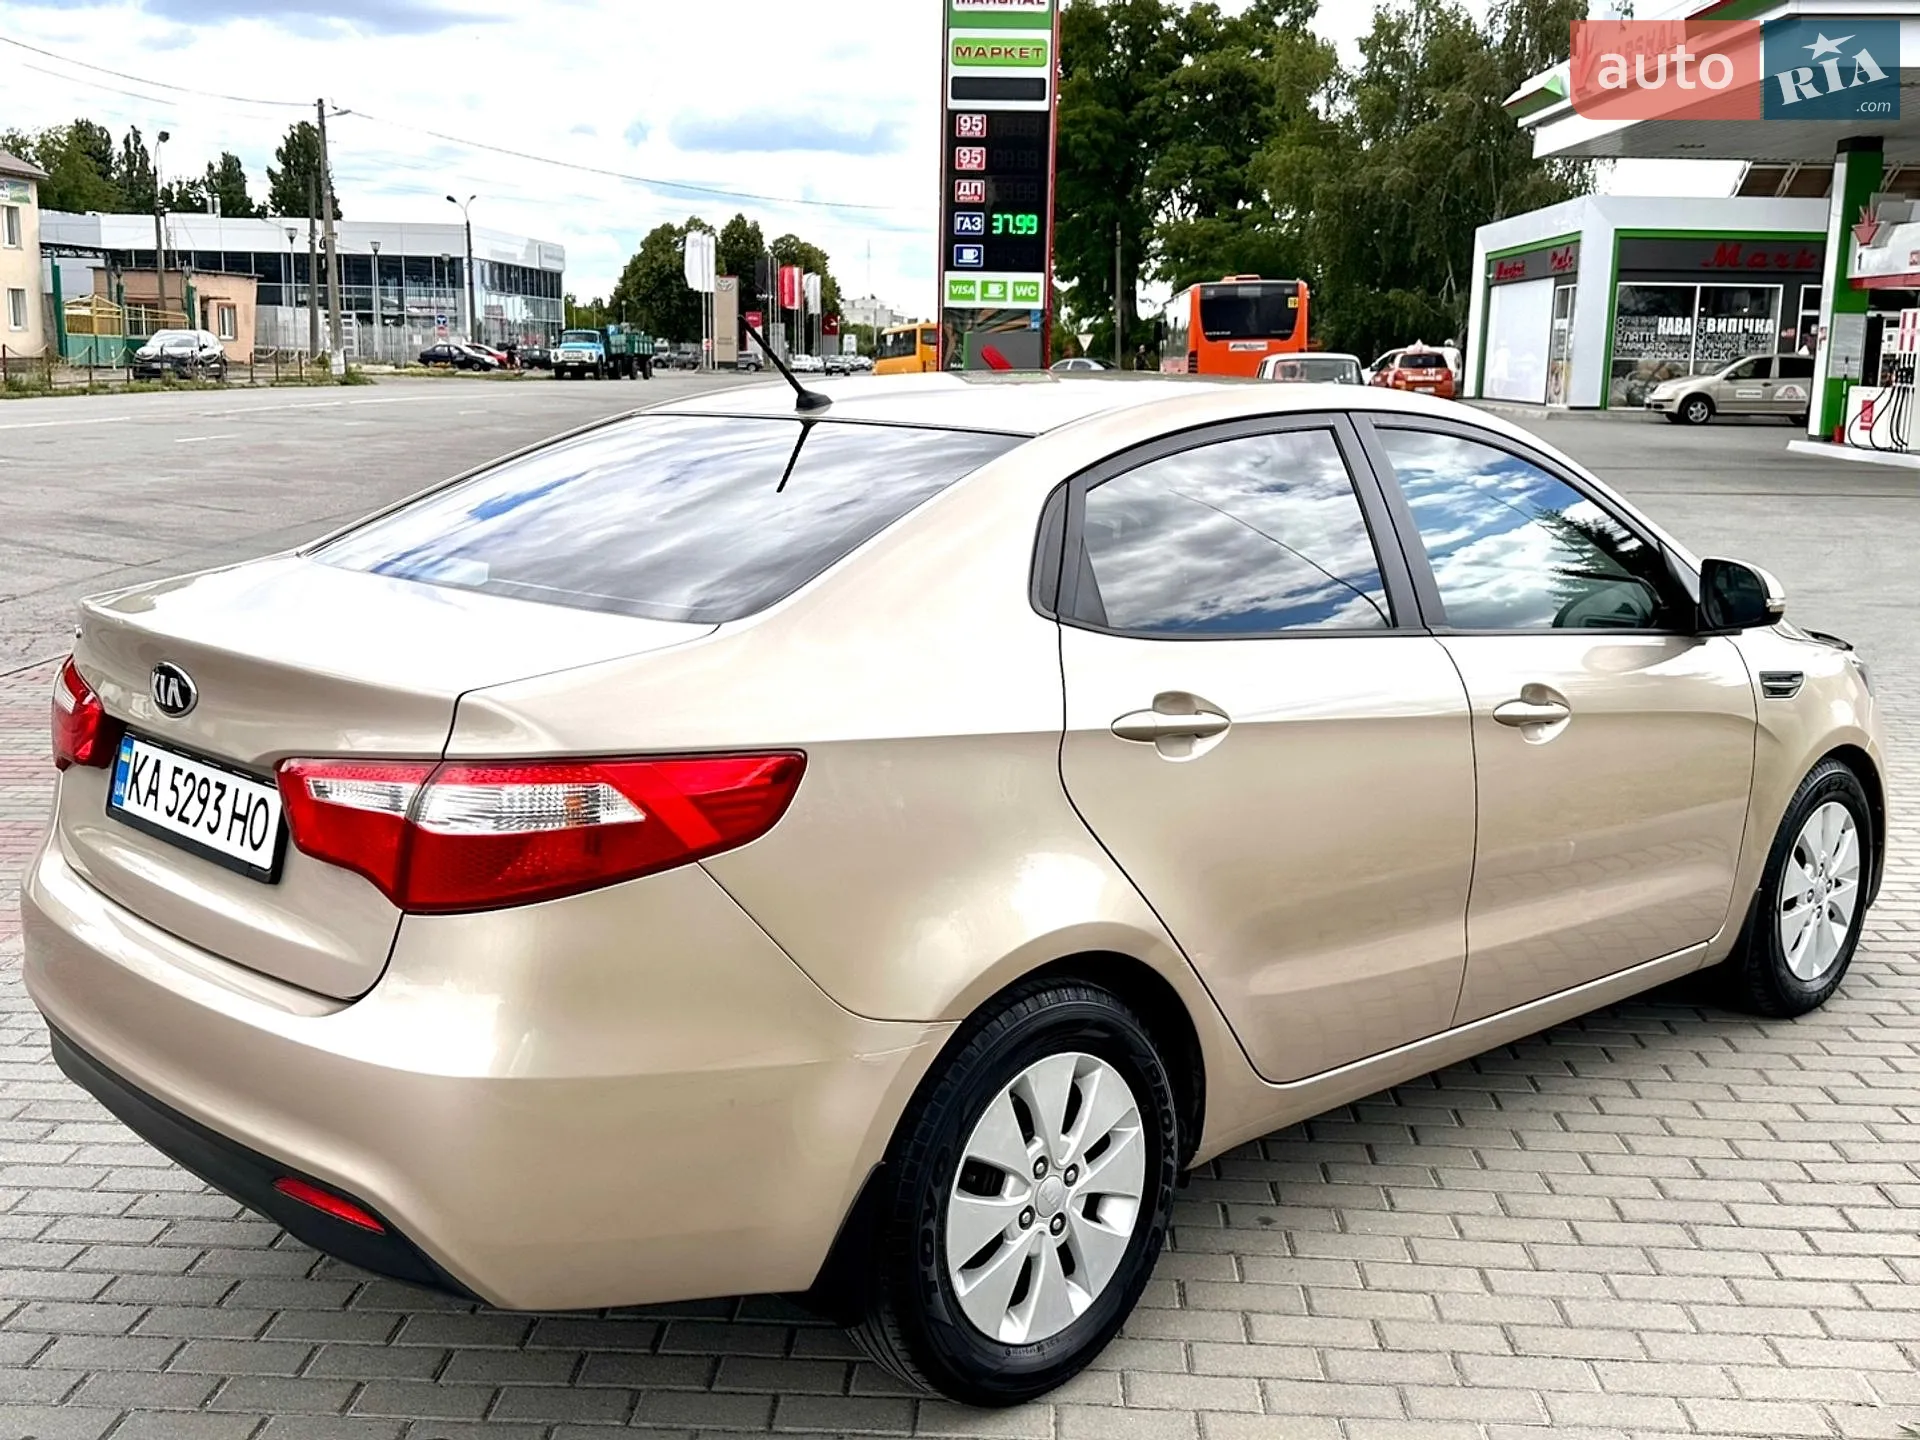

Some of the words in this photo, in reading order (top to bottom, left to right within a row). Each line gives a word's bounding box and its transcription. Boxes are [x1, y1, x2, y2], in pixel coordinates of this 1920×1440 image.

[960, 116, 982, 131] 95
[959, 149, 981, 164] 95
[958, 182, 981, 195] ДП
[957, 217, 981, 230] ГАЗ
[992, 214, 1038, 235] 37.99
[951, 284, 975, 294] VISA
[1015, 285, 1037, 297] WC
[1657, 317, 1692, 335] КАВА
[1706, 317, 1775, 334] ВИПІЧКА
[152, 673, 184, 708] KIA
[128, 751, 162, 812] KA
[165, 766, 227, 836] 5293
[227, 788, 269, 852] HO
[918, 1145, 950, 1306] TOYO
